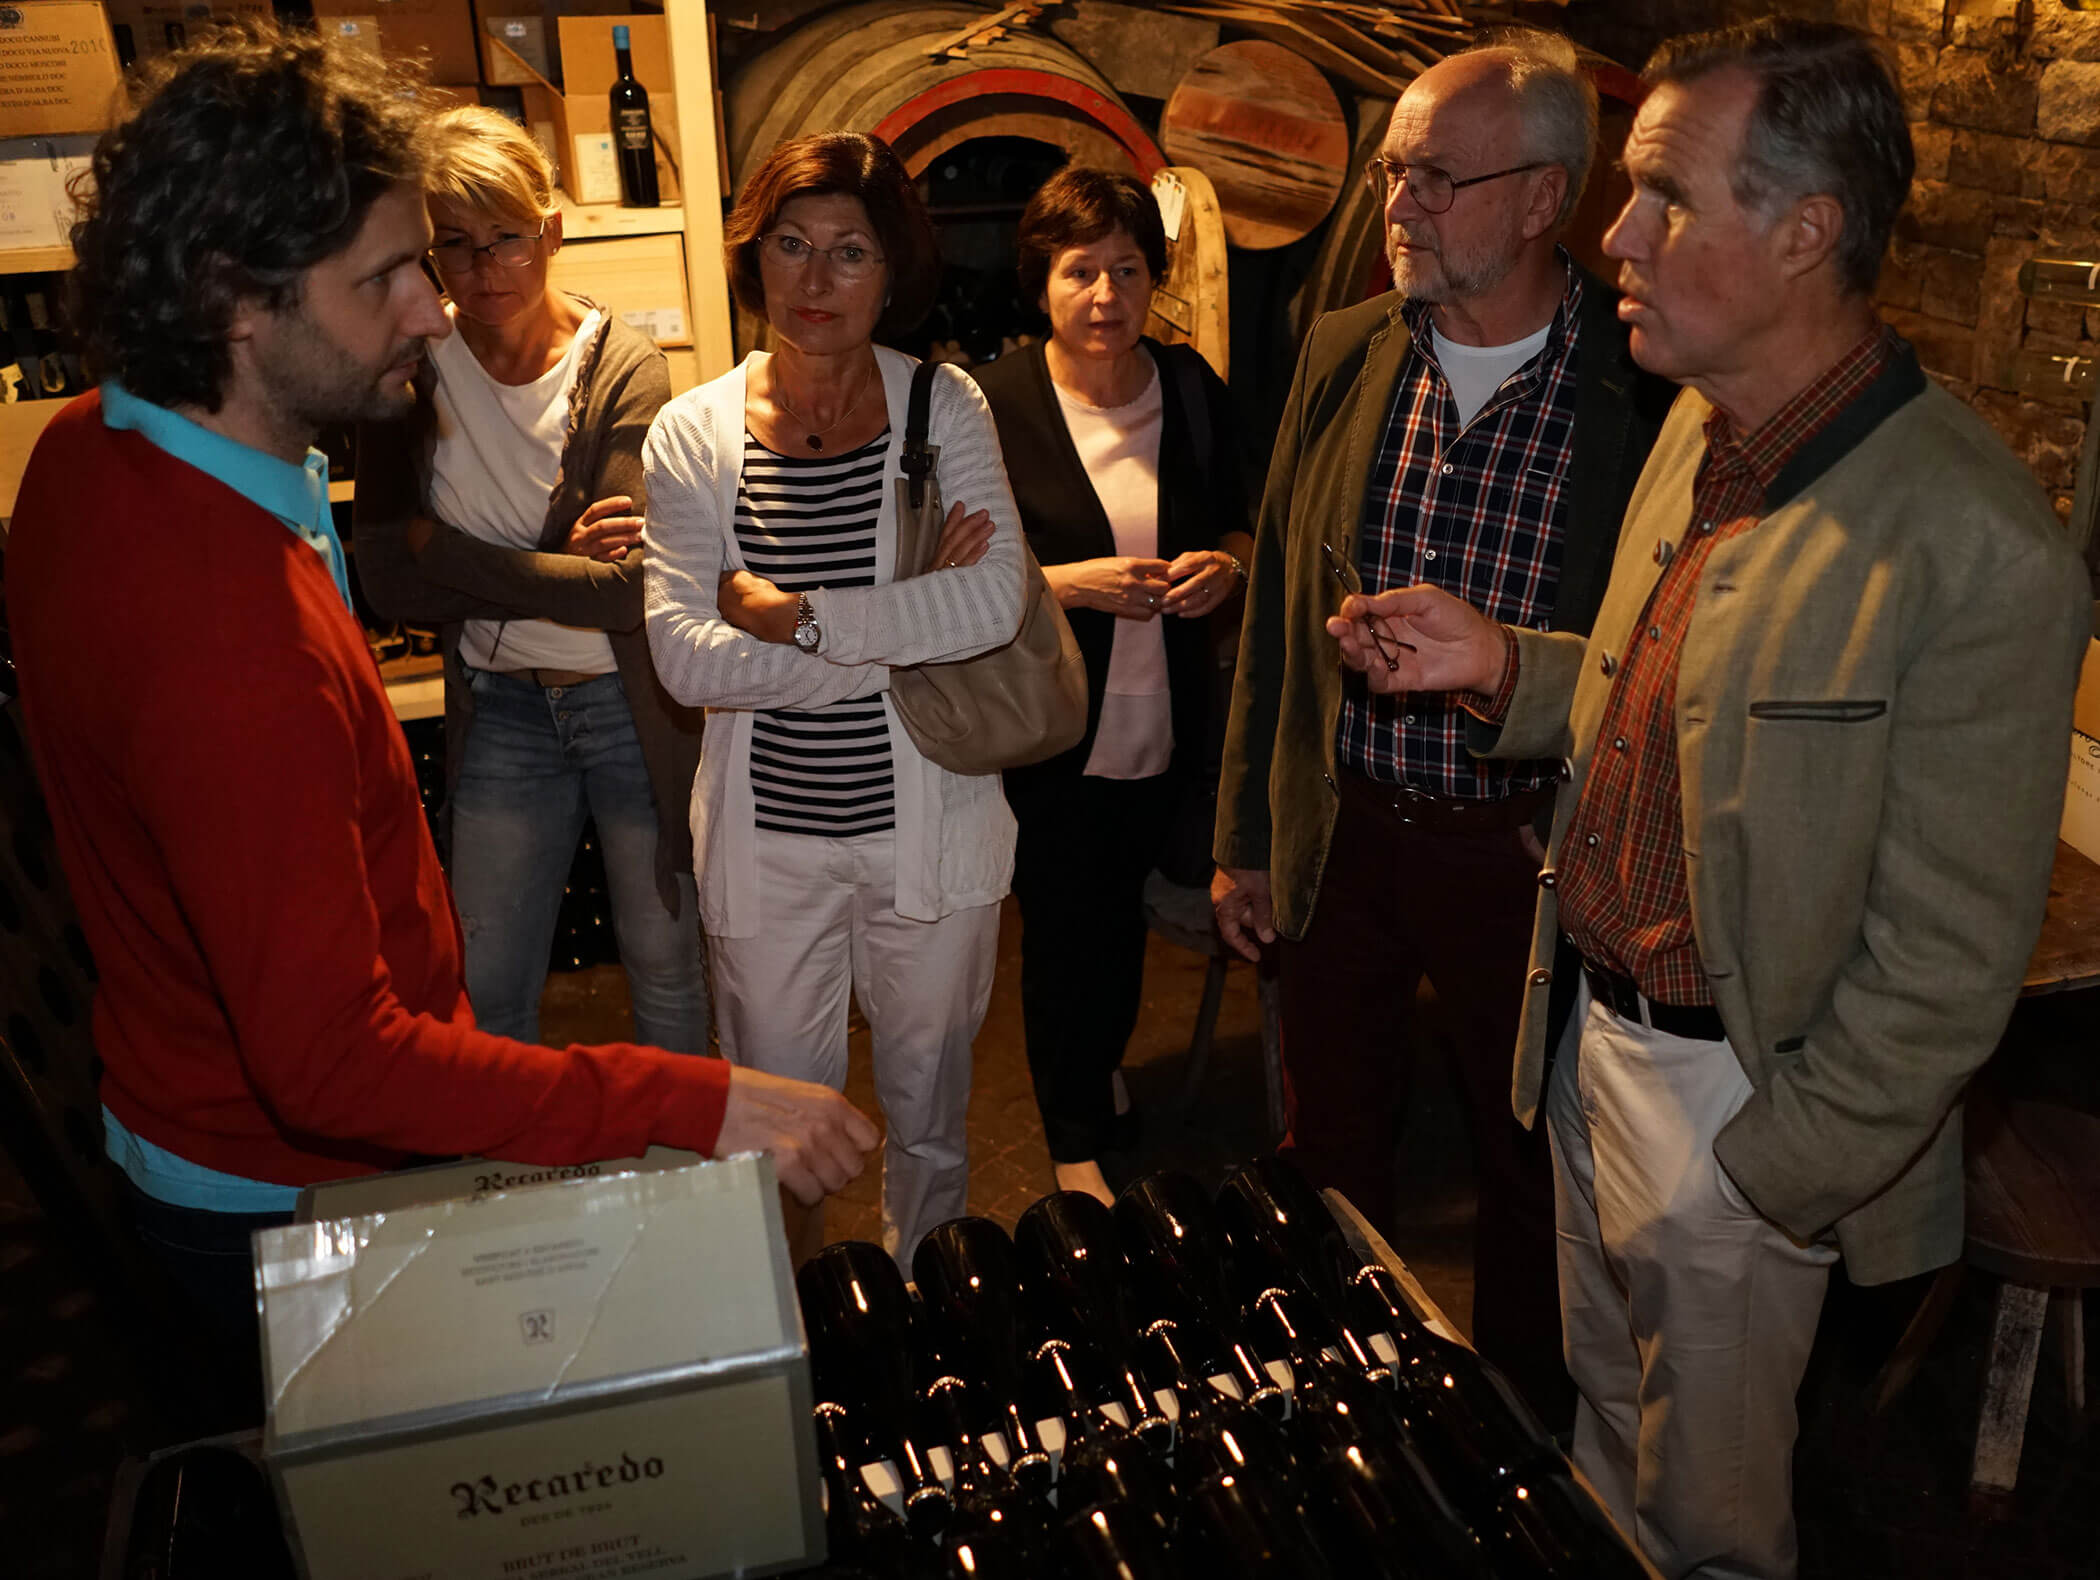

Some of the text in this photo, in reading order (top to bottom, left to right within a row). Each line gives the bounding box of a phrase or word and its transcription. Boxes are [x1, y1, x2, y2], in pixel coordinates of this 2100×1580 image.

[474, 1164, 600, 1192] Recaredo
[450, 1450, 664, 1520] Recaredo
[502, 1534, 640, 1573] BRUT DE BRUT
